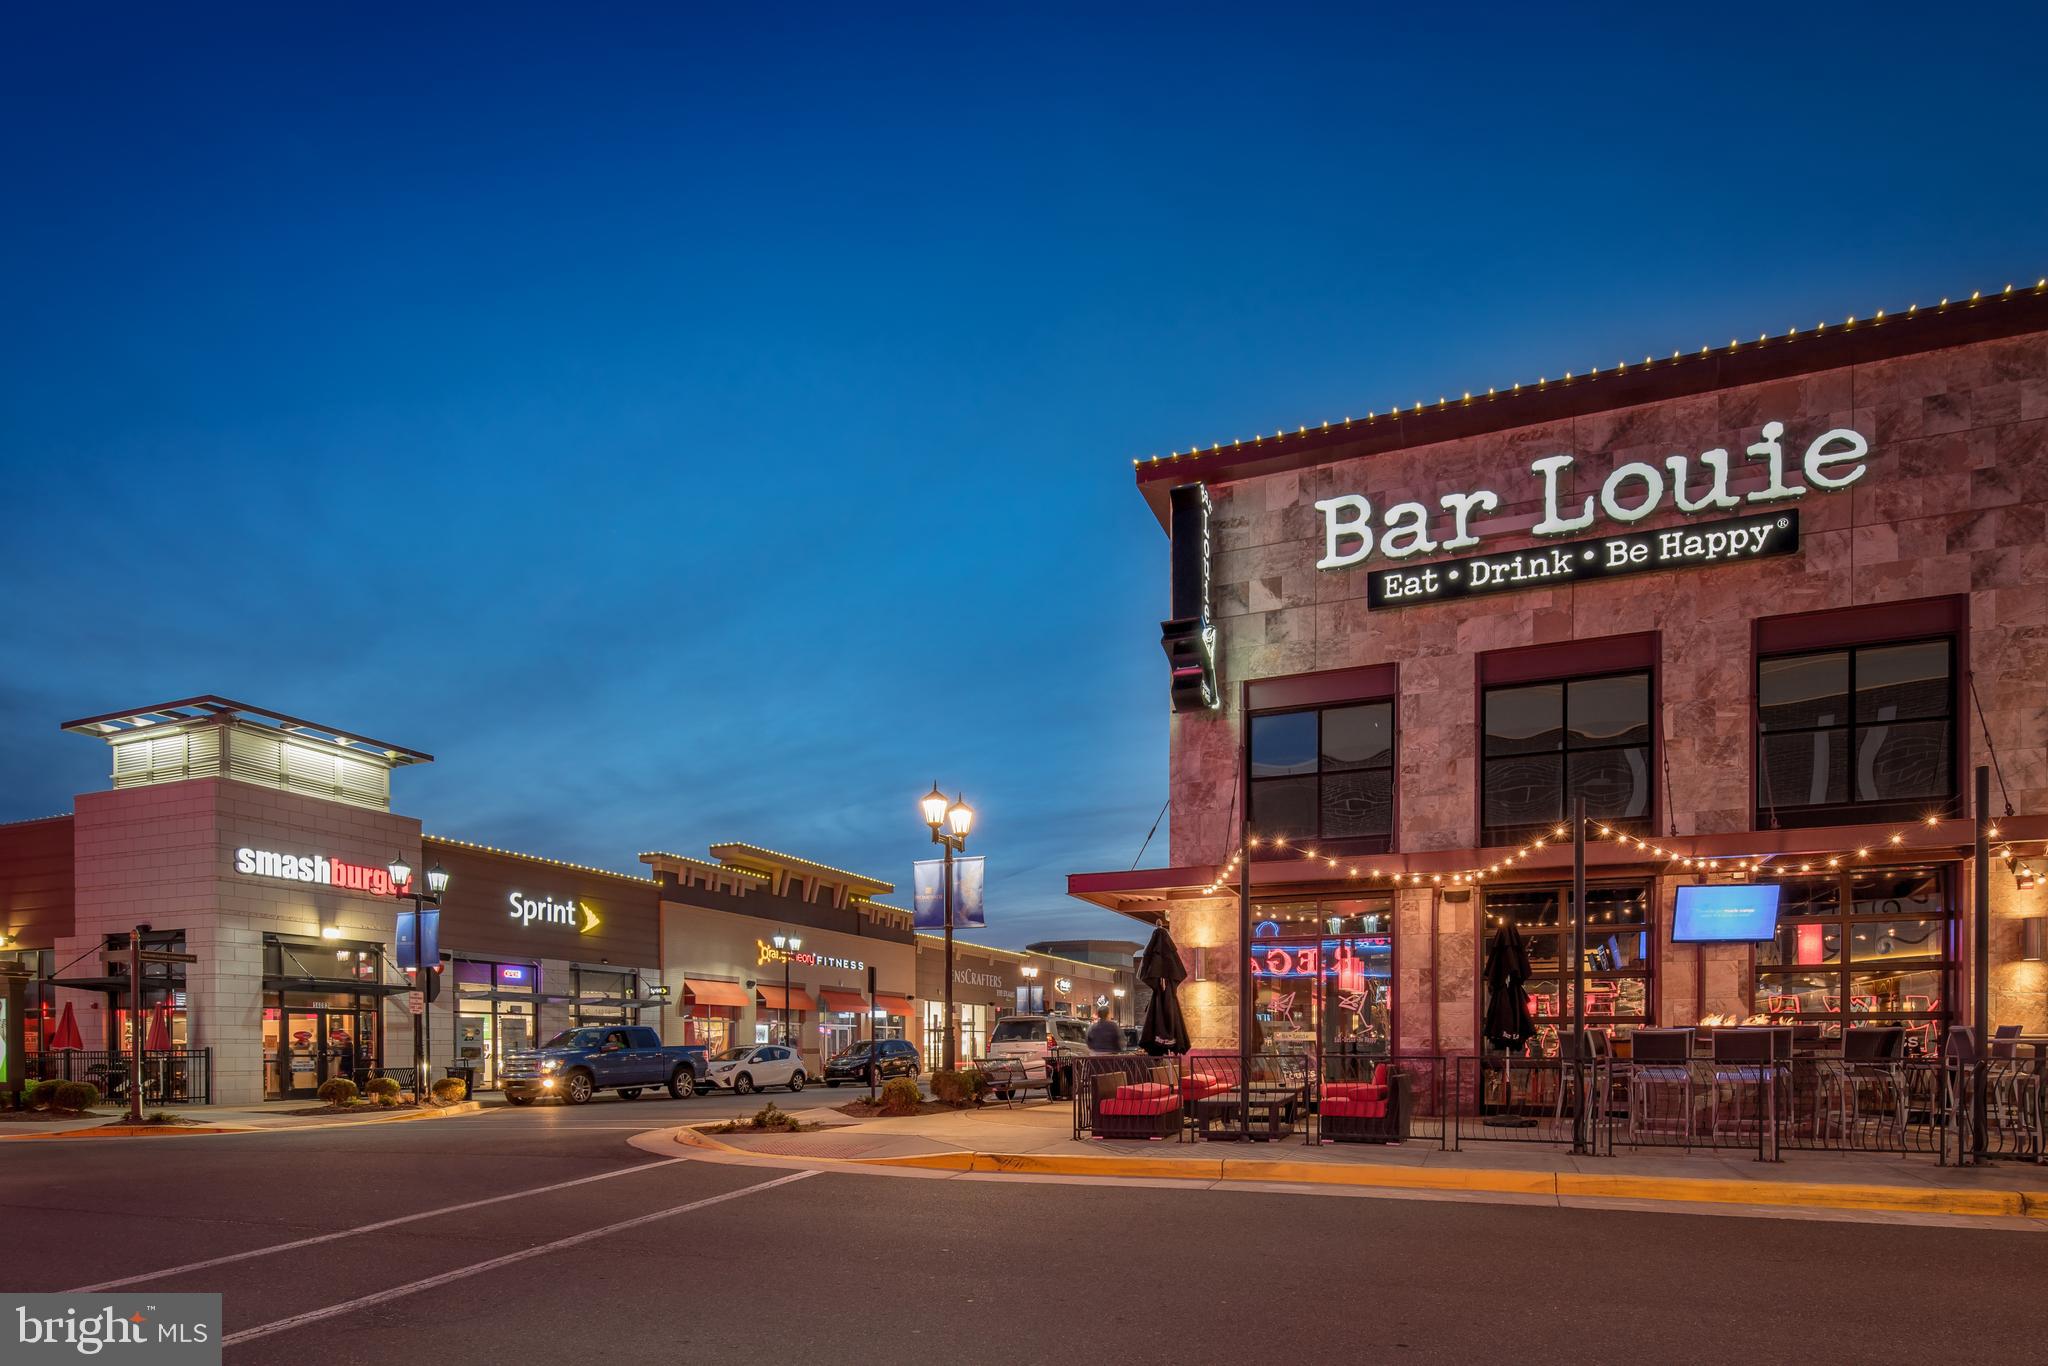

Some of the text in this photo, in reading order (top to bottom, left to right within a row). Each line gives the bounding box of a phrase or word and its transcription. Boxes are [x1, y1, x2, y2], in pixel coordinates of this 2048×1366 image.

[1315, 421, 1868, 570] Bar Louie
[1383, 569, 1439, 599] Eat
[1469, 550, 1573, 587] Drink
[1606, 541, 1648, 567] Be
[509, 892, 576, 926] Sprint
[816, 955, 864, 971] FITNESS
